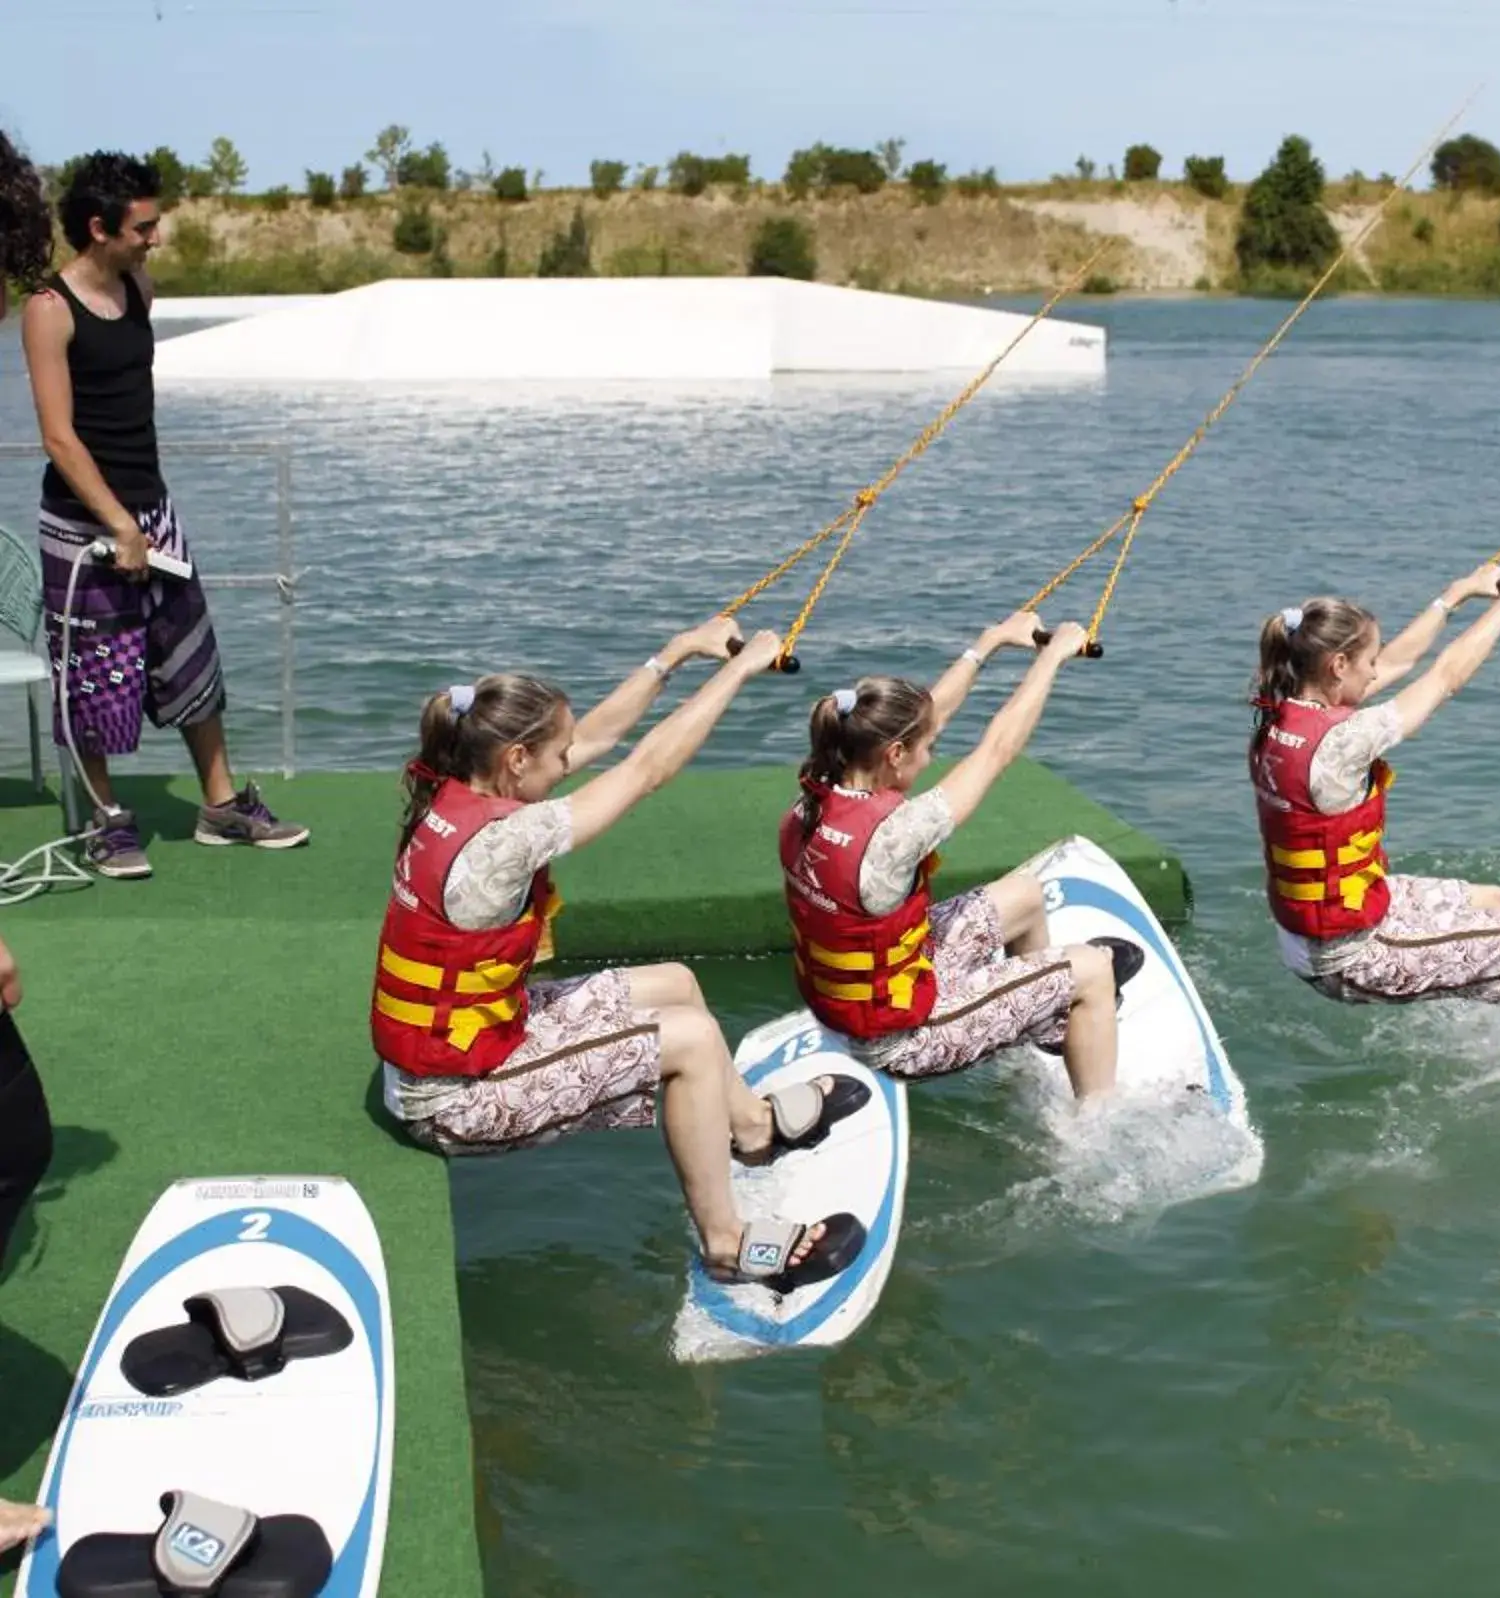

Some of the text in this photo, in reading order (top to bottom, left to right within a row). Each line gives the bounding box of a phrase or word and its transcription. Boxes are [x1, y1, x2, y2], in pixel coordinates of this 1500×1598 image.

[1043, 879, 1065, 911] 3
[783, 1030, 822, 1064] 13
[238, 1212, 273, 1240] 2
[171, 1525, 219, 1563] ICA
